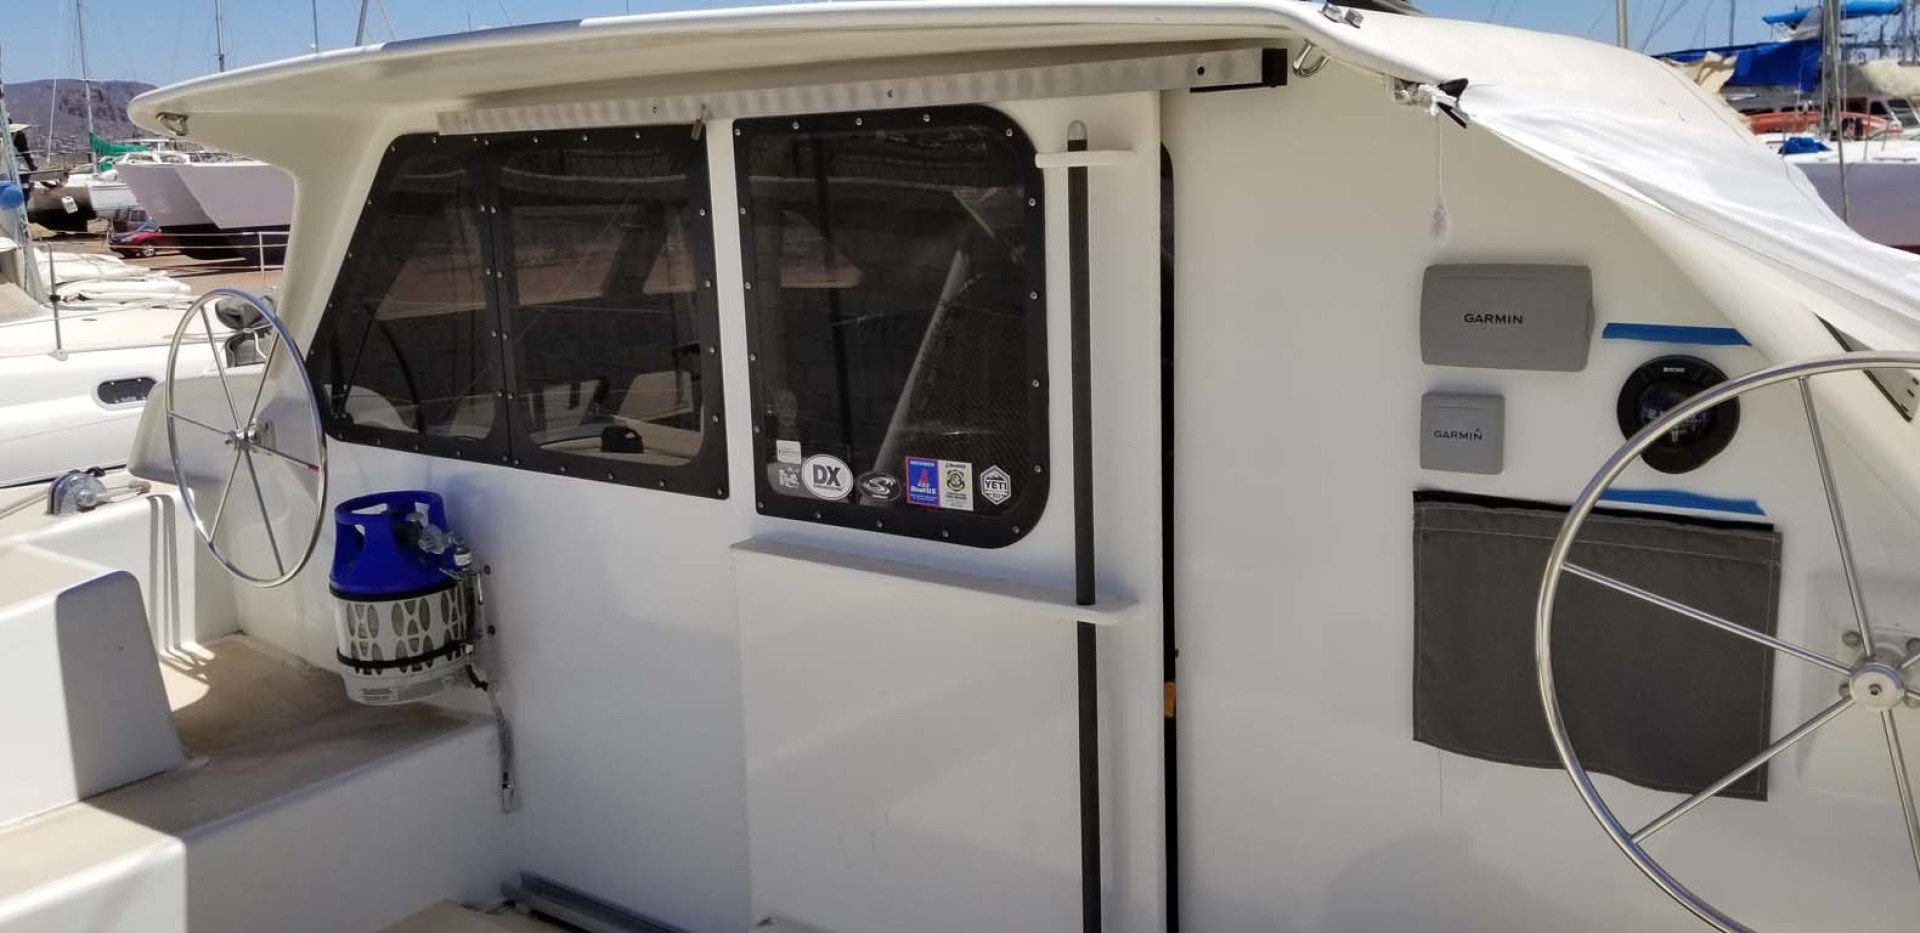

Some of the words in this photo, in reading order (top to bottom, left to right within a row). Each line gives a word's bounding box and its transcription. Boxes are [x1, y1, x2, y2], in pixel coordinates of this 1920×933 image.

[1463, 313, 1524, 325] GARMIN
[1433, 429, 1483, 441] GARMIN
[812, 463, 842, 487] DX
[985, 480, 1008, 491] YETI
